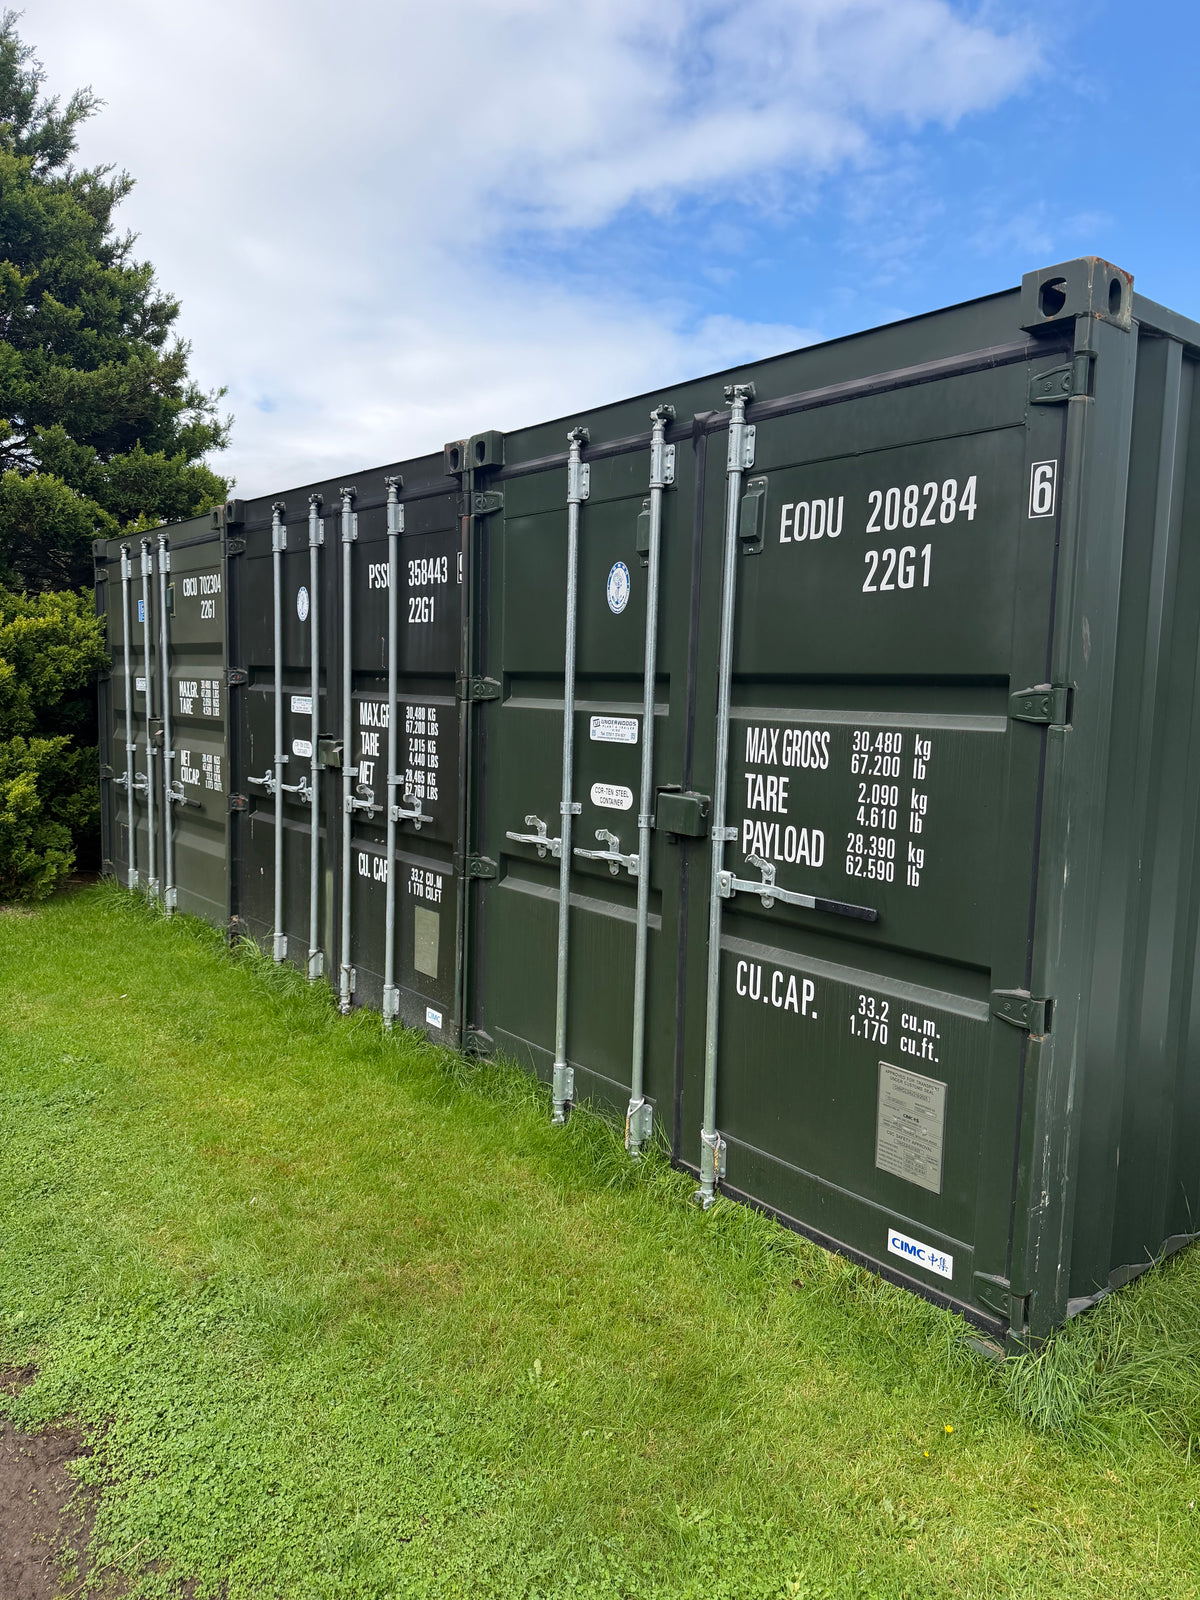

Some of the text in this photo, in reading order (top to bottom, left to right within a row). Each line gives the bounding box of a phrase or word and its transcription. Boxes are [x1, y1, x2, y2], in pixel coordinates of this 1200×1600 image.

[779, 464, 1054, 544] EODU 208284 6
[408, 556, 448, 587] 358443
[862, 543, 933, 593] 22G1
[183, 574, 221, 597] CBCU 702304
[200, 600, 215, 618] 22G1
[408, 596, 434, 623] 22G1
[180, 698, 194, 715] TARE
[406, 706, 436, 722] 30,480 KG
[406, 720, 439, 736] 67,200 LBS
[360, 732, 380, 757] TARE
[408, 738, 436, 754] 2,015 KG
[745, 727, 831, 770] MAX GROSS
[852, 731, 932, 761] 30,480 kg
[181, 750, 191, 766] NET
[408, 752, 439, 768] 4,440 LBS
[851, 754, 926, 780] 67,200 lb
[359, 760, 375, 785] NET
[405, 769, 436, 786] 28,465 KG
[426, 786, 438, 800] LBS
[595, 786, 629, 798] COR-TEN STEEL
[600, 797, 623, 807] CONTAINER
[744, 773, 790, 814] TARE
[857, 783, 928, 815] 2,090 kg
[856, 806, 923, 834] 4,610 lb
[742, 819, 825, 868] PAYLOAD
[846, 833, 925, 869] 28,390 kg
[410, 868, 424, 884] 33.2
[845, 855, 920, 888] 62,590 lb
[736, 961, 819, 1020] CU.CAP.
[858, 994, 941, 1040] 33.2 cu.m.
[849, 1014, 939, 1063] 1,170 cu.ft.
[892, 1238, 926, 1261] CIMC
